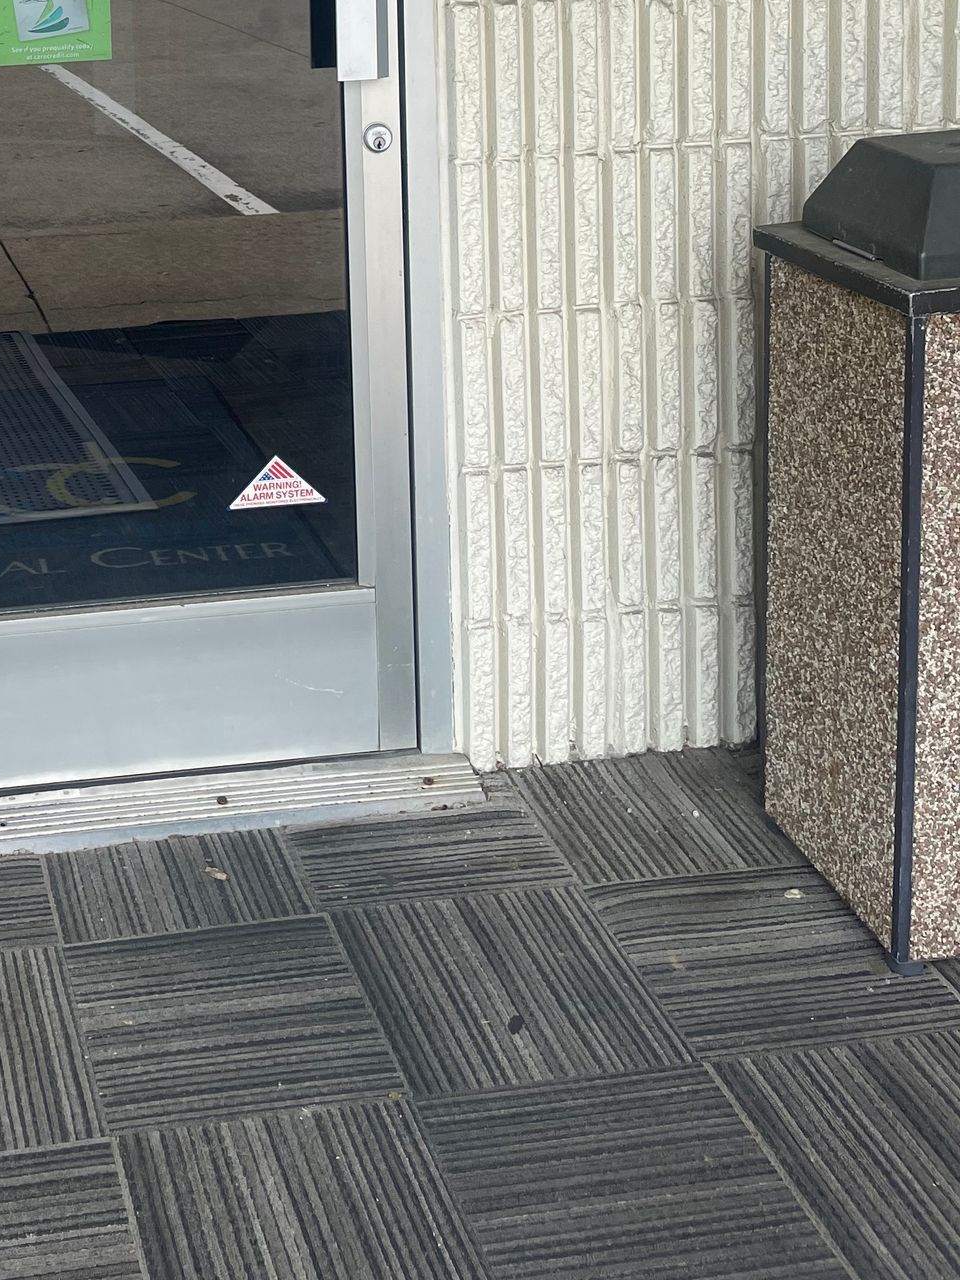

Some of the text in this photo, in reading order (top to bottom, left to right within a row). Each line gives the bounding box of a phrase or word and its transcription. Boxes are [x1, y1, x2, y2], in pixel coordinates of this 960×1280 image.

[253, 480, 302, 491] WARNING!
[240, 489, 314, 502] ALARM SYSTEM
[89, 541, 295, 570] CENTER
